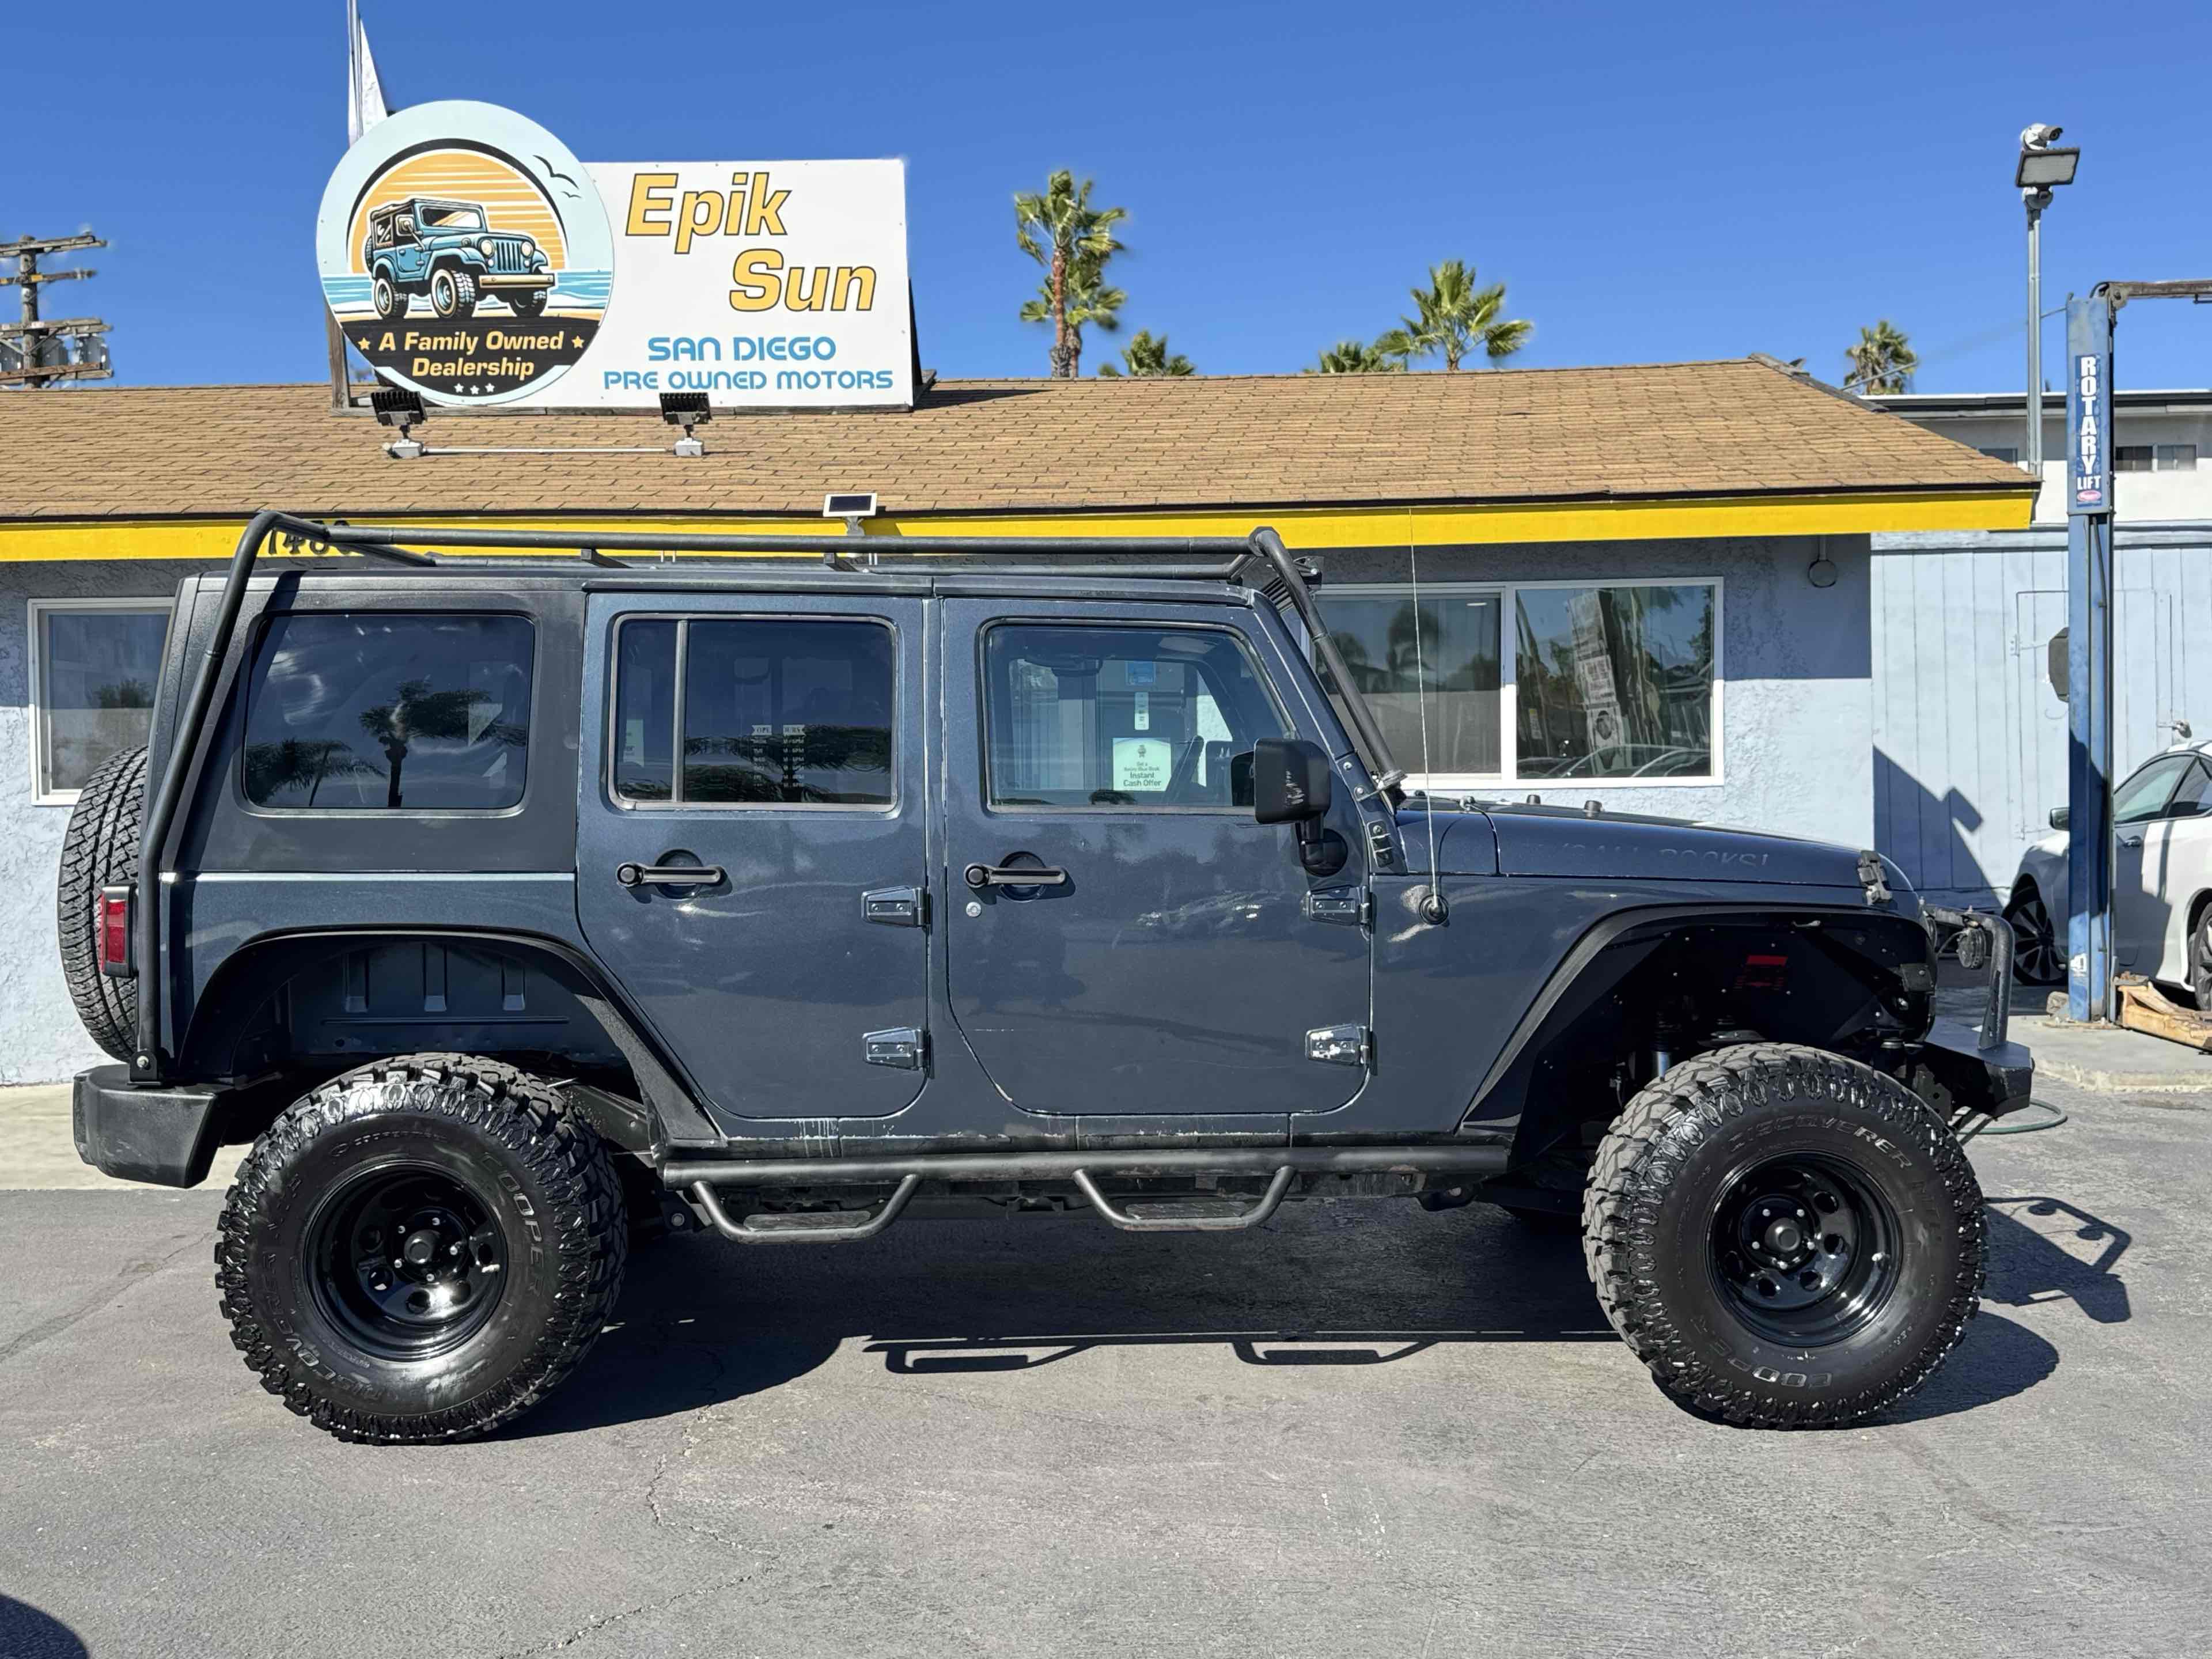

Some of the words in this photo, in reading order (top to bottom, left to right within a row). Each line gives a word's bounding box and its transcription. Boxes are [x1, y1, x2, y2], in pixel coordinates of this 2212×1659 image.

[626, 172, 792, 254] Epik
[729, 248, 877, 312] Sun
[378, 332, 396, 351] A
[404, 331, 479, 355] Family
[486, 331, 565, 351] Owned
[647, 336, 722, 361] SAN
[733, 336, 837, 361] DIEGO
[412, 358, 535, 381] Dealership
[604, 370, 658, 389] PRE
[668, 370, 767, 390] OWNED
[777, 370, 893, 390] MOTORS
[2080, 356, 2097, 475] ROTARY
[2077, 475, 2101, 490] LIFT
